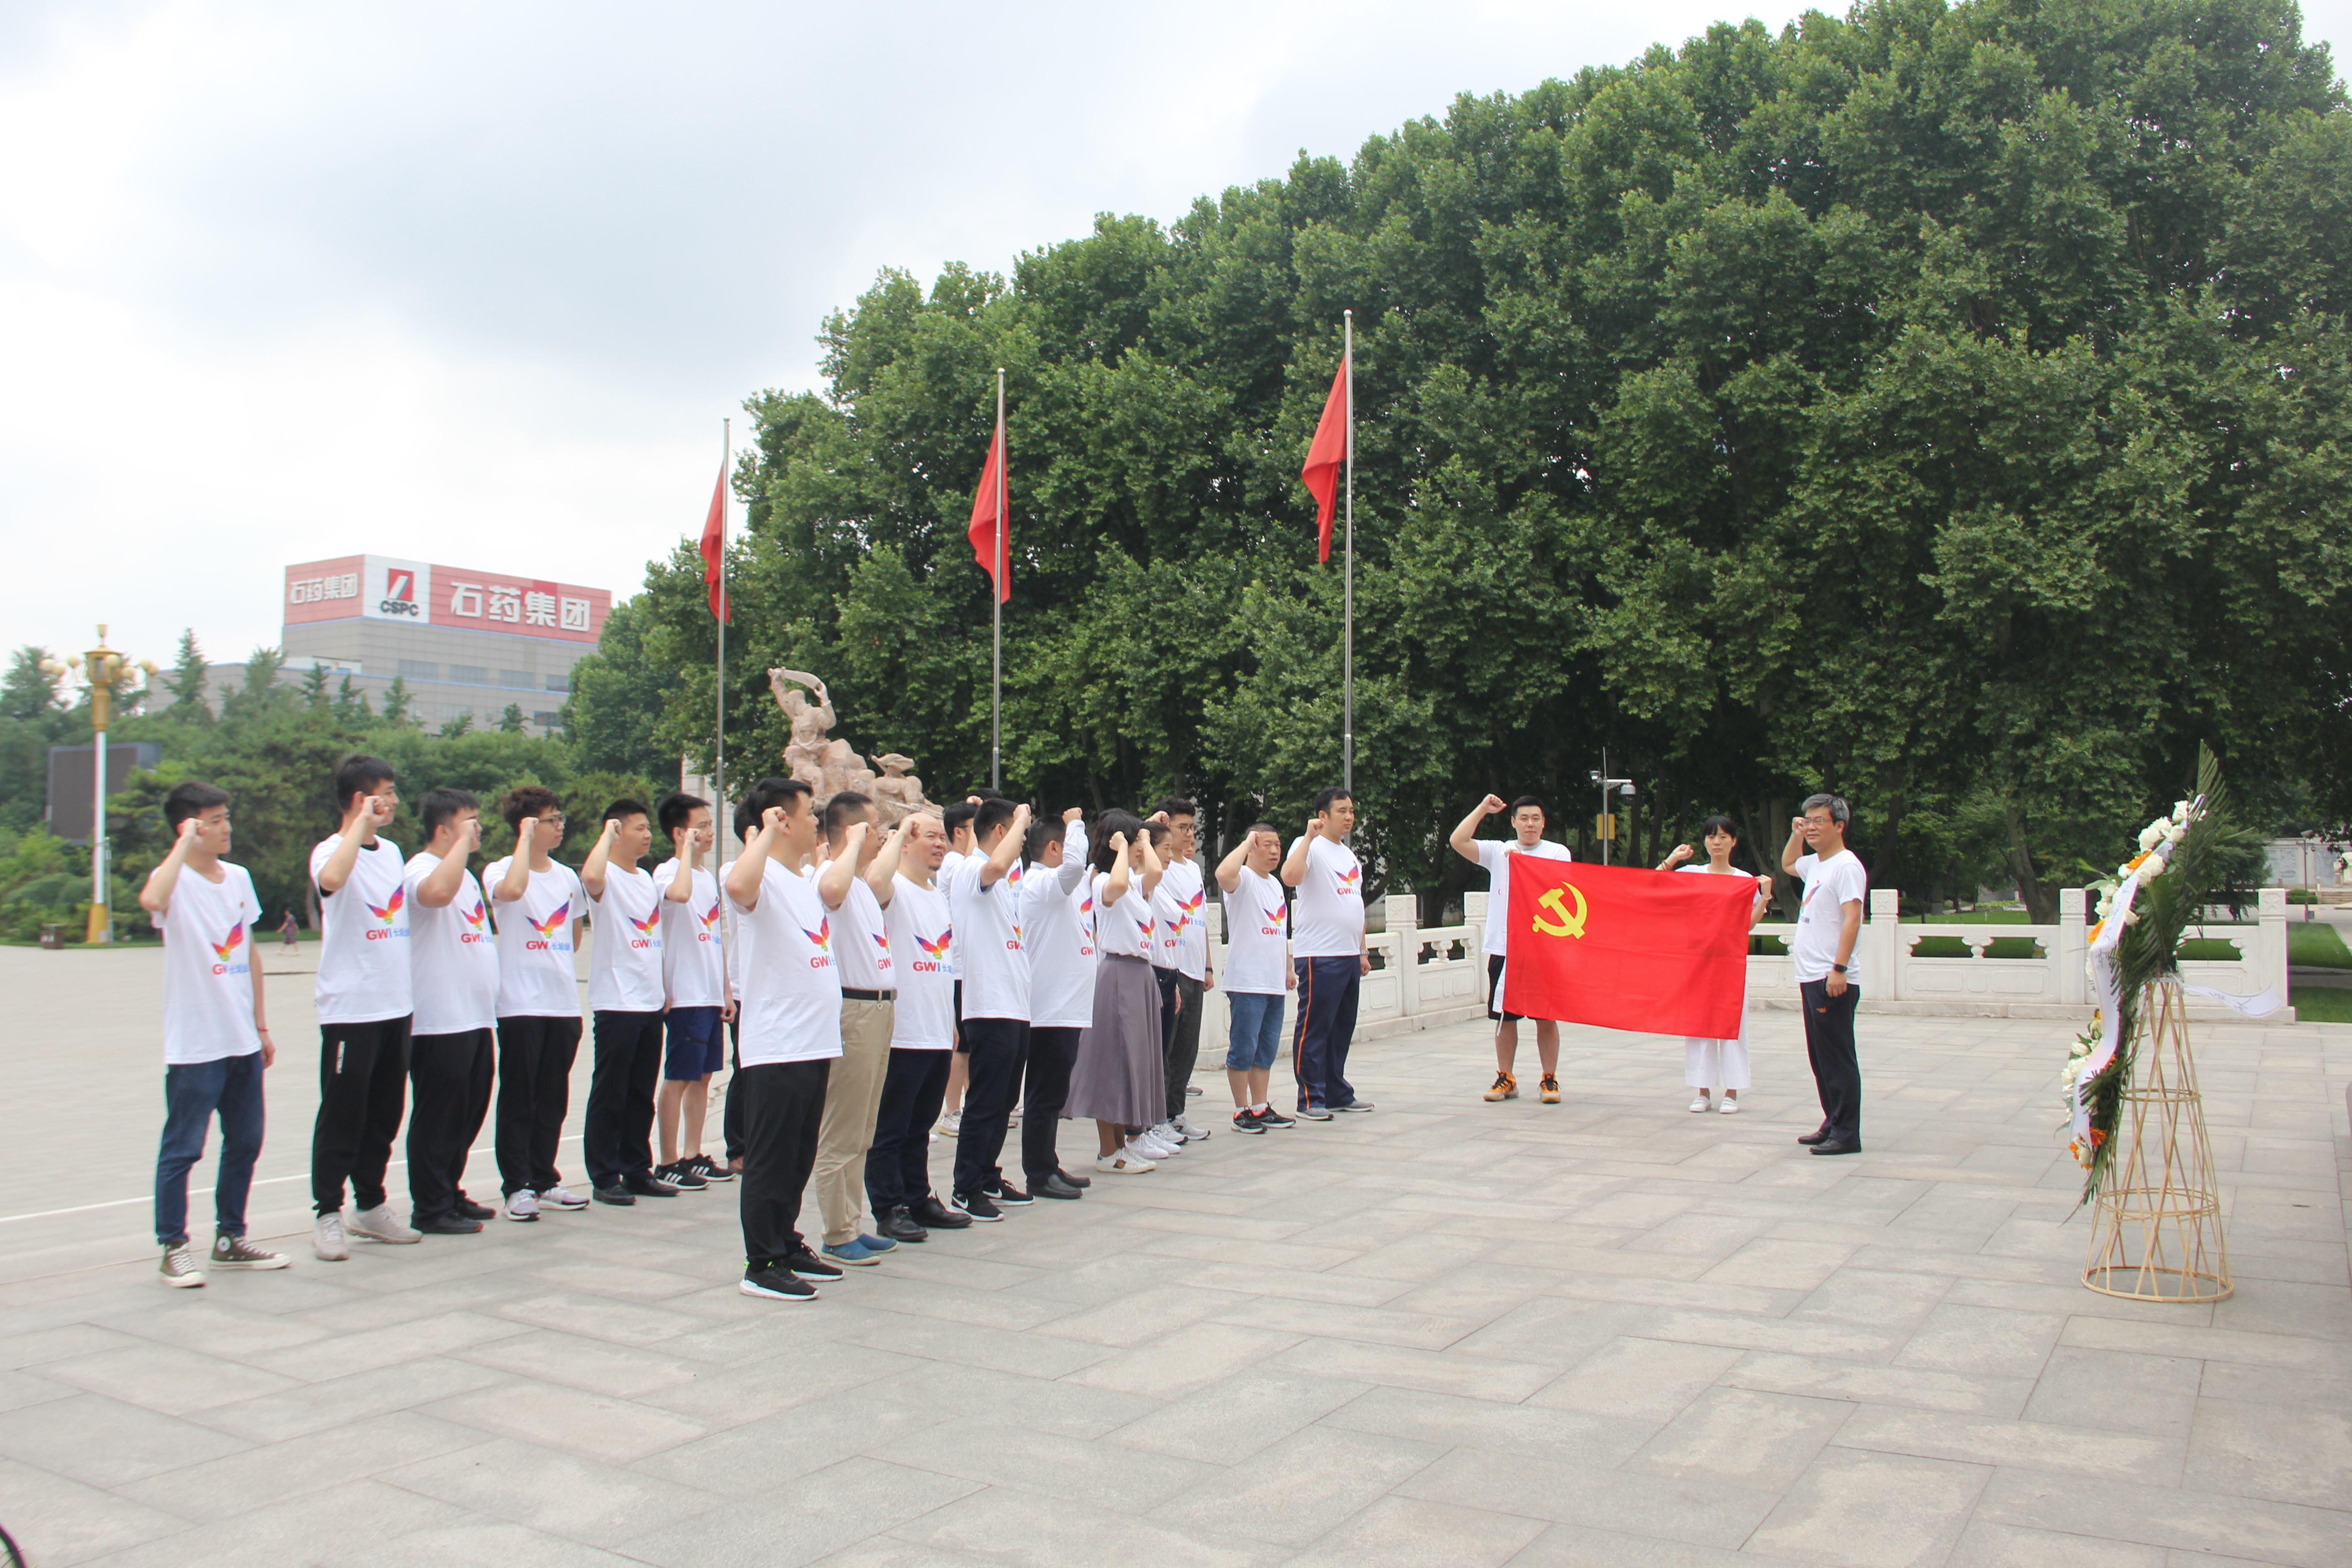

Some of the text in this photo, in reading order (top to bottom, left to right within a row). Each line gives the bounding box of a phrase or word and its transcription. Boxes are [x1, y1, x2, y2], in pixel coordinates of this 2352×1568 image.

[289, 573, 358, 604] 石药集团
[381, 600, 420, 616] CSPC
[451, 581, 590, 632] 石药集团
[366, 927, 392, 940] GWI
[1261, 927, 1280, 936] GWI
[632, 939, 652, 949] GWI
[810, 955, 832, 969] GWI
[912, 961, 941, 972] GWI
